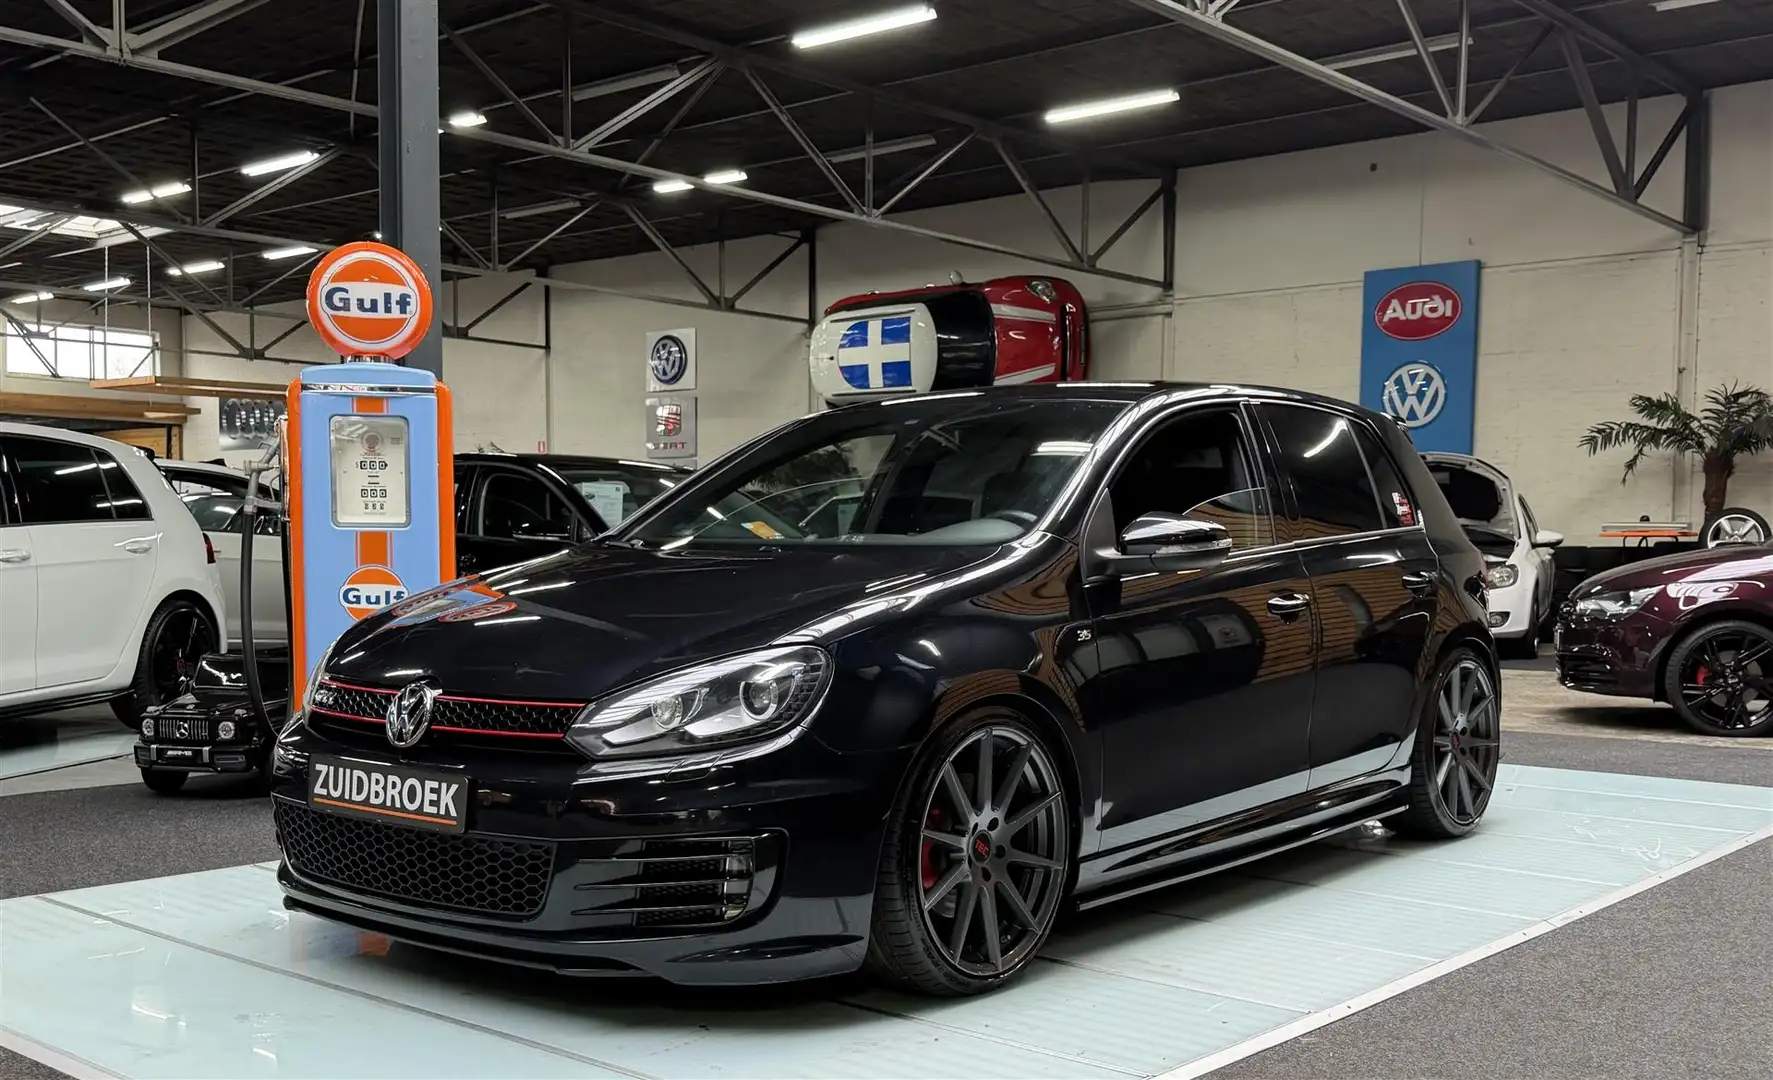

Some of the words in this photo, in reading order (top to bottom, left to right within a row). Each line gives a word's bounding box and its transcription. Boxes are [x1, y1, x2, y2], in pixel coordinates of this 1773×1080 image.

[325, 287, 411, 315] Gulf
[343, 588, 405, 605] Gulf
[1077, 629, 1091, 641] 35
[313, 764, 459, 817] ZUIDBROEK
